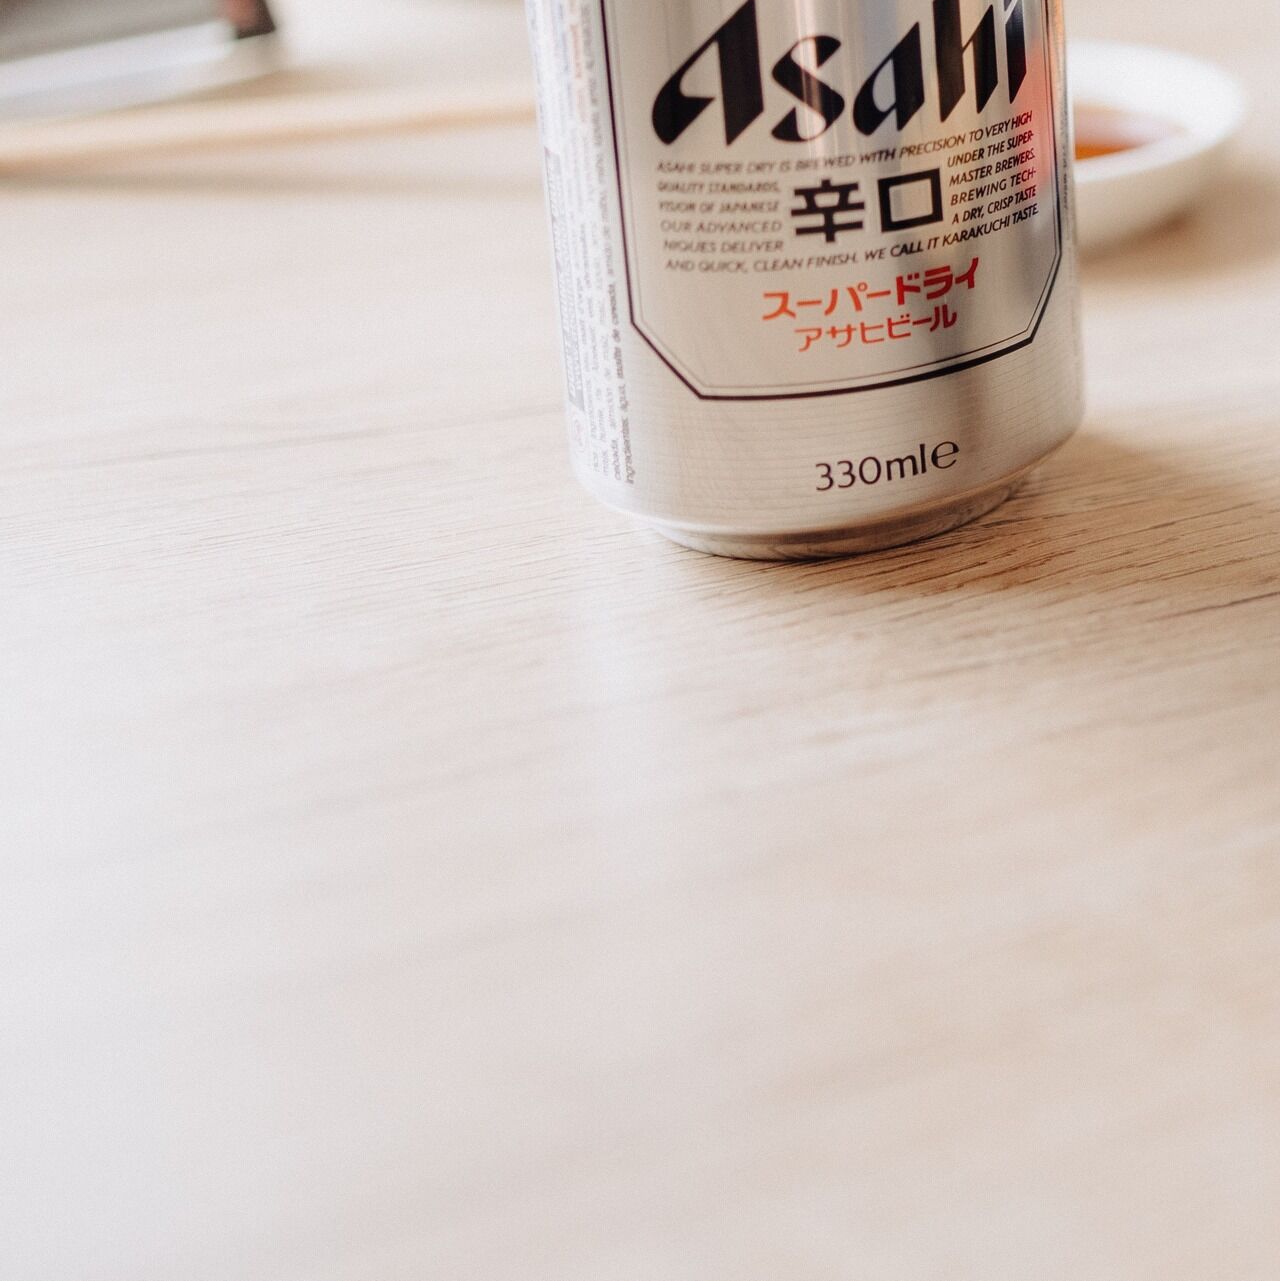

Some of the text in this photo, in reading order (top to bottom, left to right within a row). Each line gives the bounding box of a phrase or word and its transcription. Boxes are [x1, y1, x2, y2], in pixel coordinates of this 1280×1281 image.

[657, 110, 1033, 175] ASAHI SUPER DRY IS BREWED WITH PRECISION TO VERY HIGH
[657, 180, 704, 193] QUALITY
[946, 147, 985, 168] UNDER
[987, 140, 1005, 158] THE
[1007, 130, 1035, 151] SUPER-
[660, 200, 696, 213] VISION
[701, 200, 714, 213] OF
[719, 200, 780, 213] JAPANESE
[949, 164, 992, 187] MASTER
[660, 167, 1036, 233] OUR ADVANCED BREWING TECH-
[664, 185, 1037, 254] NIQUES DELIVER A DRY, CRISP TASTE
[791, 168, 943, 242] 辛口
[665, 259, 694, 272] AND
[700, 259, 748, 274] QUICK,
[753, 257, 803, 272] CLEAN
[864, 247, 887, 262] WE
[890, 240, 924, 258] CALL
[927, 236, 940, 251] IT
[942, 215, 1010, 247] KARAKUCHI
[762, 257, 979, 320] スーパードライ
[794, 304, 957, 352] アサヒビール
